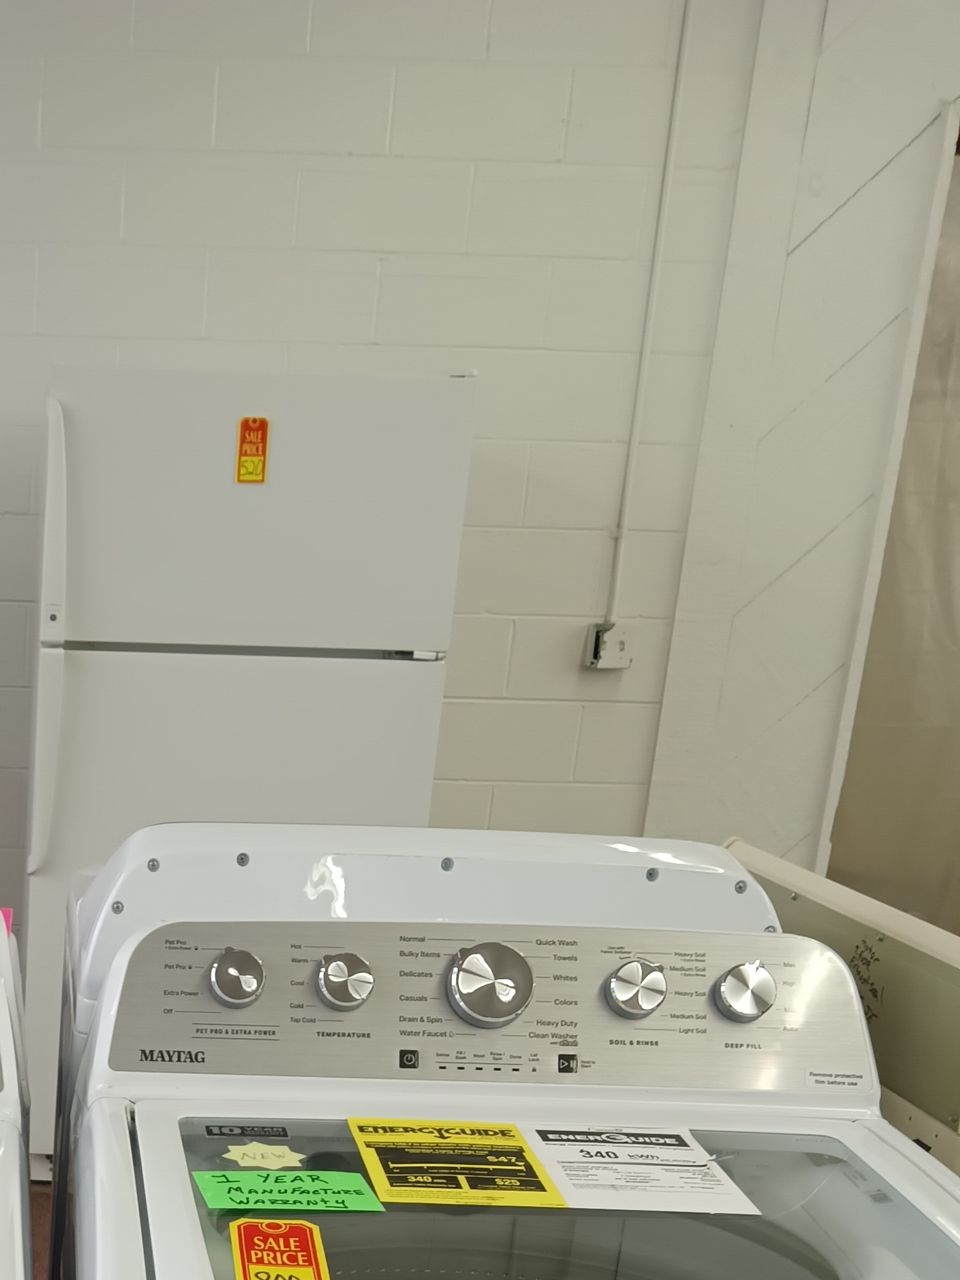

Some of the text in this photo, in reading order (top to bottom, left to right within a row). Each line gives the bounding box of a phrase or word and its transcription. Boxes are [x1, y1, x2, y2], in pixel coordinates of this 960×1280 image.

[244, 430, 263, 442] SALE
[242, 443, 264, 455] PRICE
[399, 950, 419, 958] Bulky
[536, 1020, 559, 1028] Heavy
[140, 1050, 205, 1063] MAYTAG
[209, 1126, 242, 1134] 10
[357, 1125, 516, 1139] ENERGYGUIDE
[240, 1151, 286, 1161] NEW
[486, 1155, 517, 1163] $47
[579, 1149, 619, 1159] 340
[211, 1174, 329, 1184] 1 YEAR
[407, 1175, 432, 1183] 340
[495, 1178, 521, 1186] $25
[227, 1186, 365, 1196] MANUFACTURE
[229, 1197, 349, 1209] WARRANTY
[253, 1236, 300, 1251] SALE
[251, 1251, 309, 1266] PRICE
